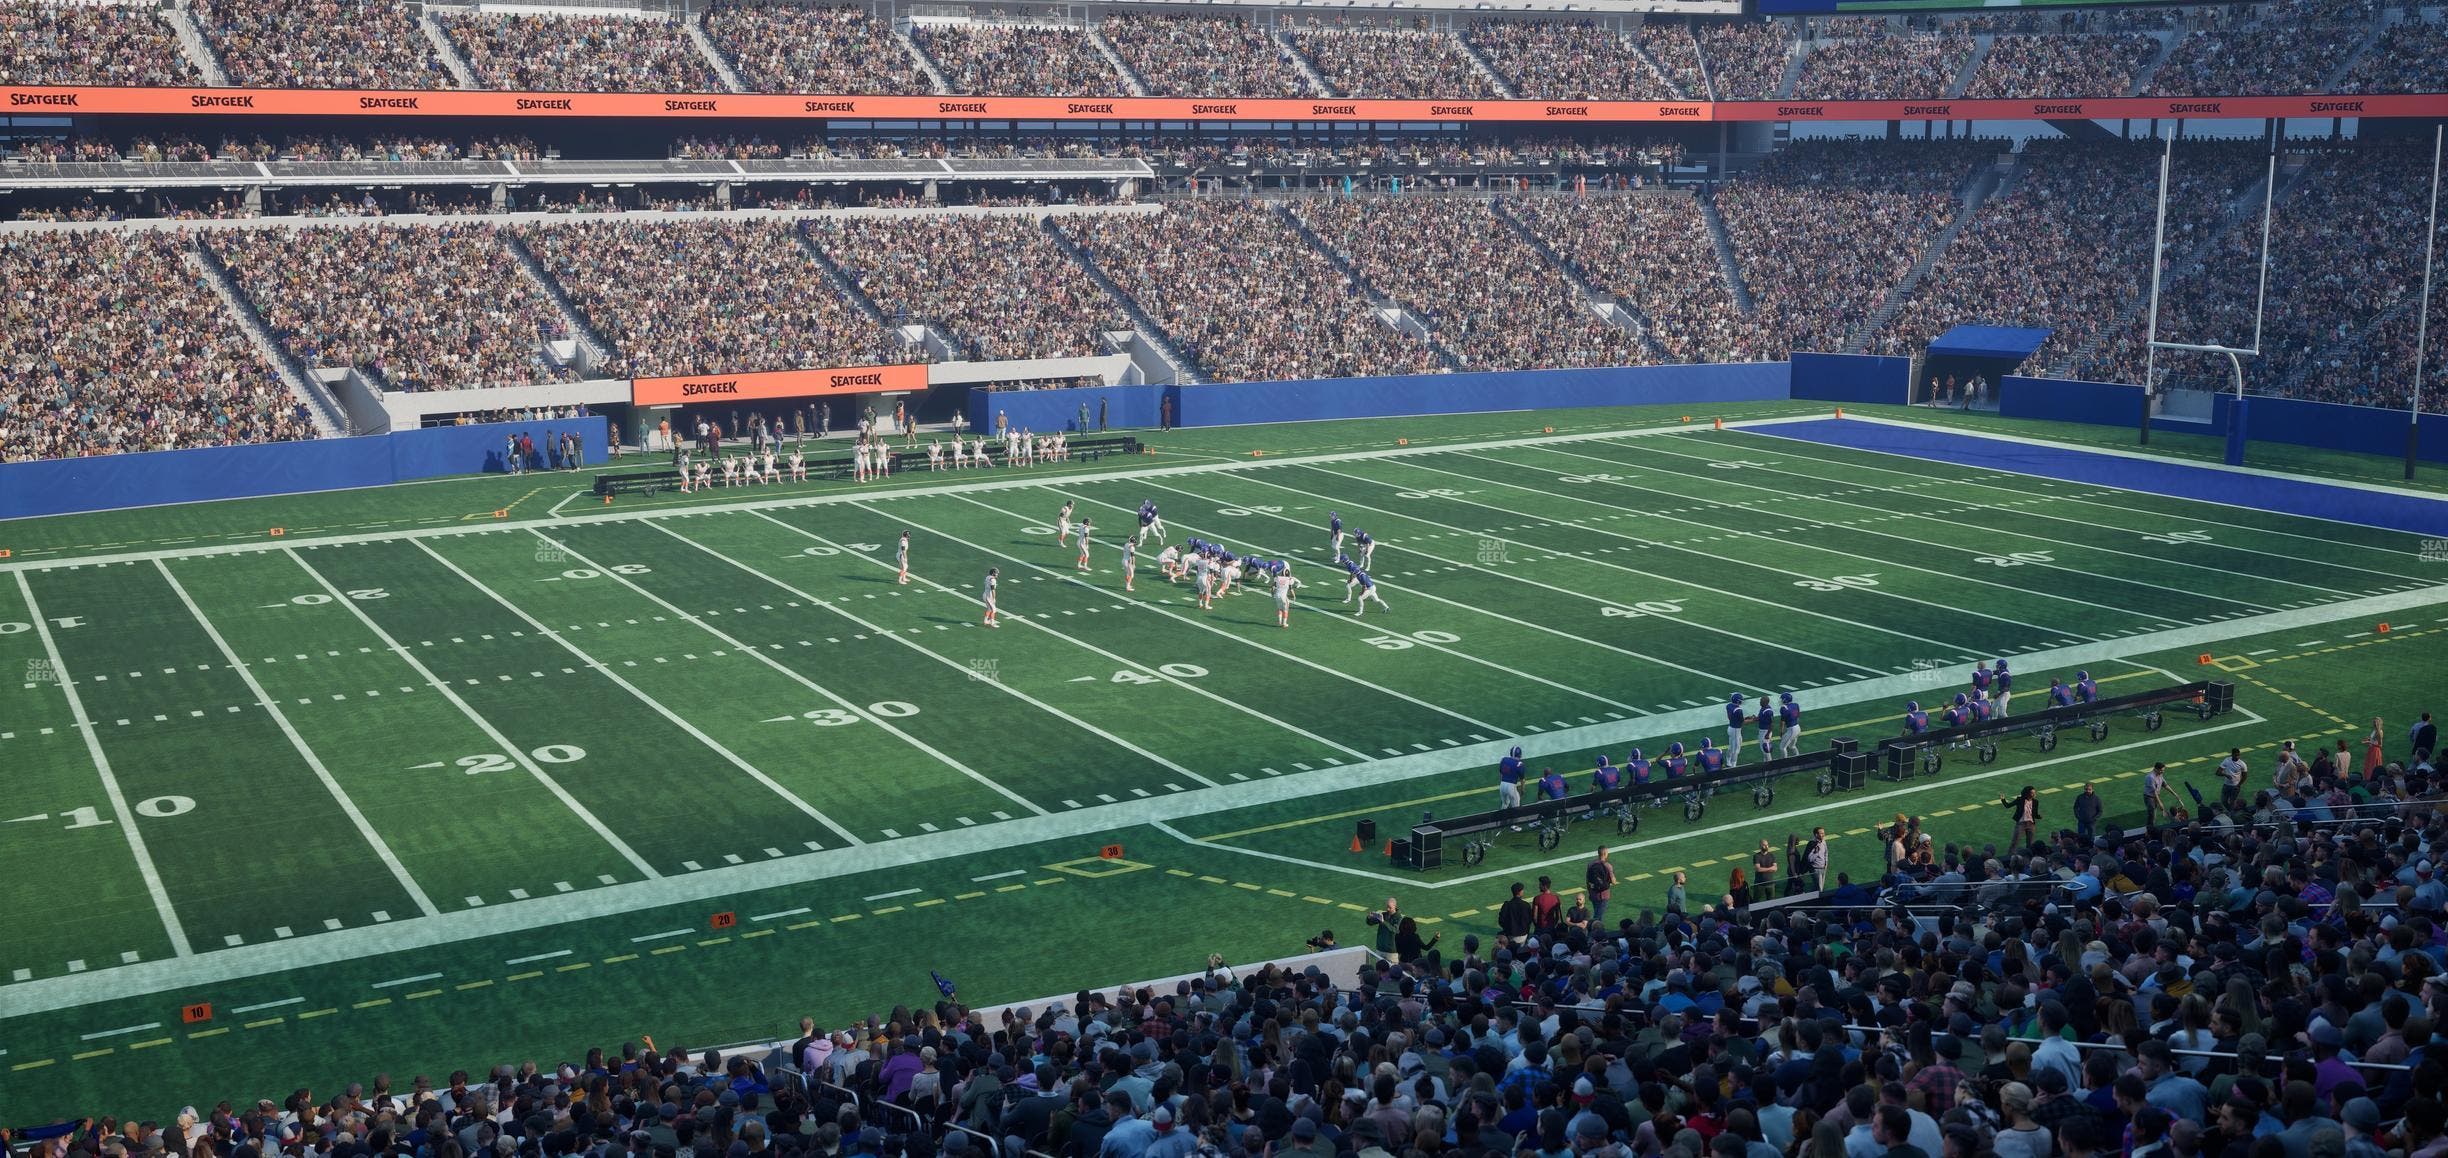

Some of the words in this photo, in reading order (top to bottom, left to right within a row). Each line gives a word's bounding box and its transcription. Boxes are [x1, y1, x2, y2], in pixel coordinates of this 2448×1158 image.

[10, 93, 79, 107] SEATGEEK
[191, 95, 254, 108] SEATGEEK
[359, 97, 419, 109] SEATGEEK
[516, 98, 572, 111] SEATGEEK
[665, 100, 717, 112] SEATGEEK
[805, 101, 855, 113] SEATGEEK
[939, 102, 987, 113] SEATGEEK
[1067, 103, 1113, 114] SEATGEEK
[1192, 104, 1237, 115] SEATGEEK
[1312, 105, 1356, 115] SEATGEEK
[1431, 105, 1473, 116] SEATGEEK
[1546, 106, 1588, 116] SEATGEEK
[1659, 106, 1700, 117] SEATGEEK
[1777, 106, 1824, 117] SEATGEEK
[1903, 105, 1951, 116] SEATGEEK
[2033, 104, 2083, 115] SEATGEEK
[2168, 102, 2221, 114] SEATGEEK
[2309, 100, 2365, 113] SEATGEEK
[830, 373, 882, 387] SEATGEEK
[682, 380, 738, 396] SEATGEEK
[2142, 531, 2213, 544] 10
[1974, 552, 2055, 567] 20
[1793, 575, 1880, 591] 30
[1601, 601, 1683, 618] 40
[1360, 630, 1461, 650] 50
[1111, 663, 1209, 685] 40
[803, 701, 920, 727] 30
[455, 744, 587, 775] 20
[60, 796, 196, 829] 10
[1107, 846, 1119, 857] 30
[718, 914, 730, 926] 20
[191, 1006, 203, 1018] 10
